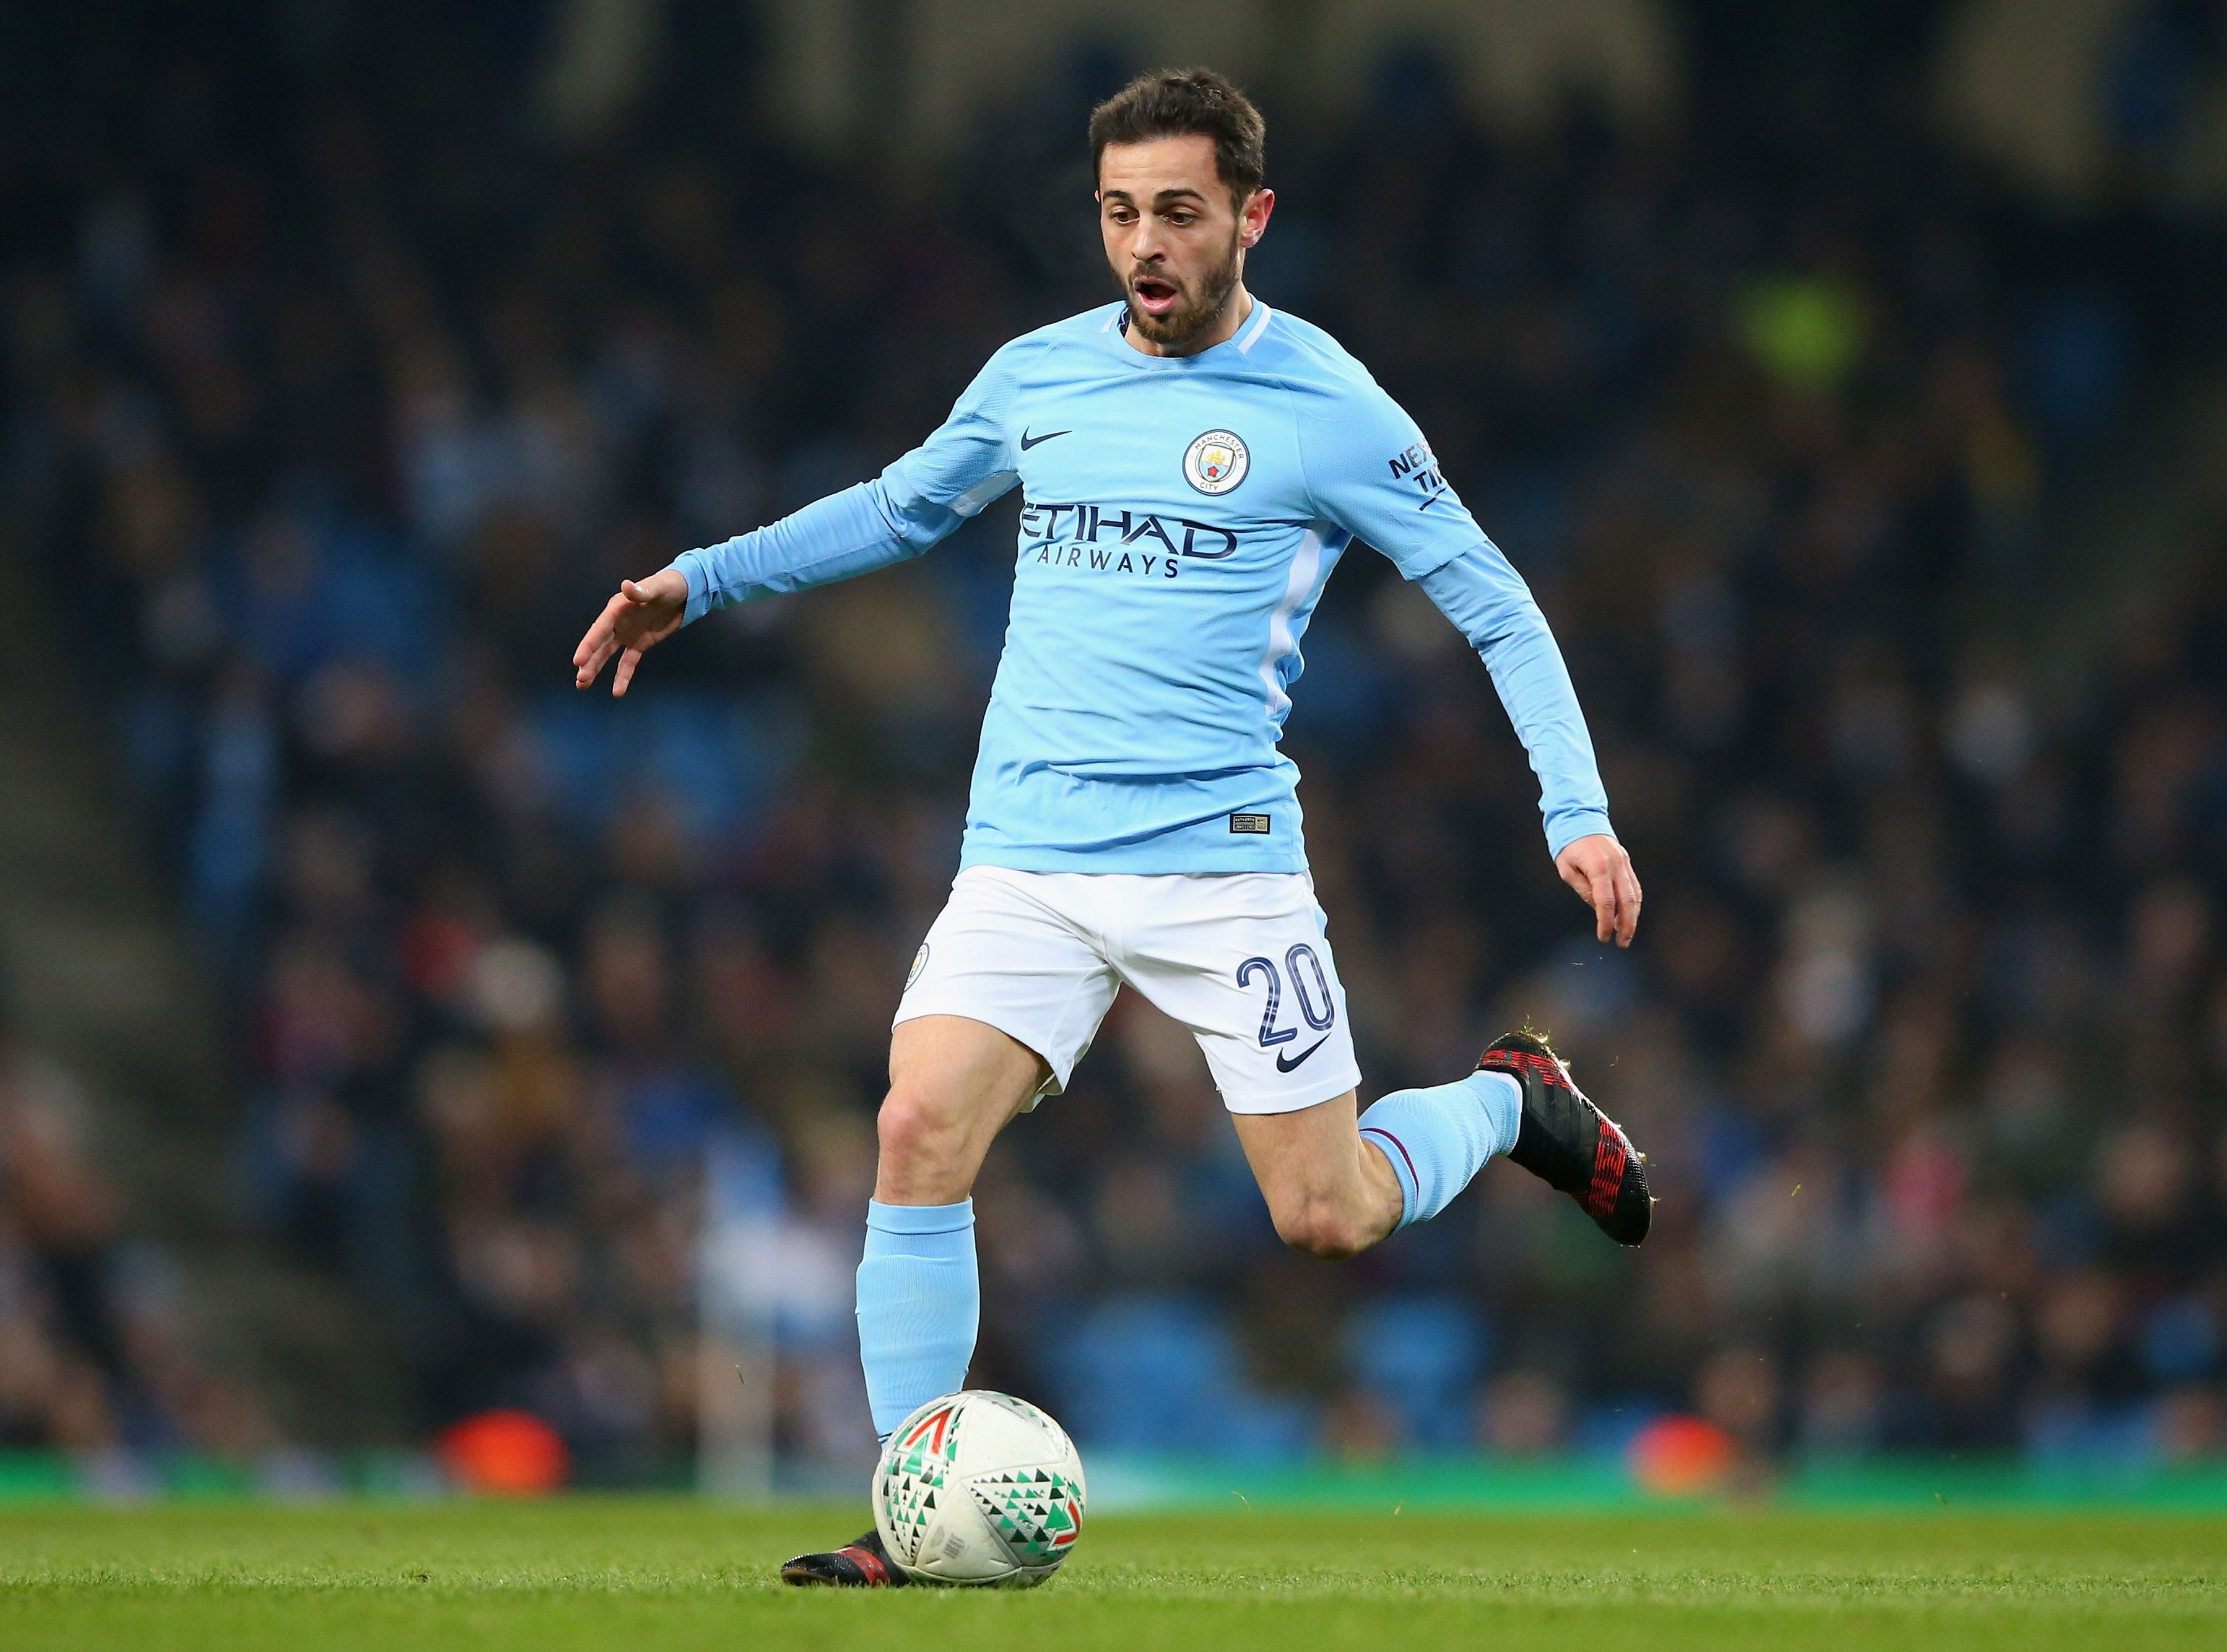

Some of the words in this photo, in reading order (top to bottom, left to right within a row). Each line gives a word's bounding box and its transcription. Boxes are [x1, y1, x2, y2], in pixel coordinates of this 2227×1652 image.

[1194, 434, 1244, 459] MANCHESTER
[1199, 482, 1218, 491] CITY
[1022, 503, 1238, 559] ETIHAD
[1036, 544, 1178, 578] AIRWAYS
[1236, 943, 1335, 1048] 20
